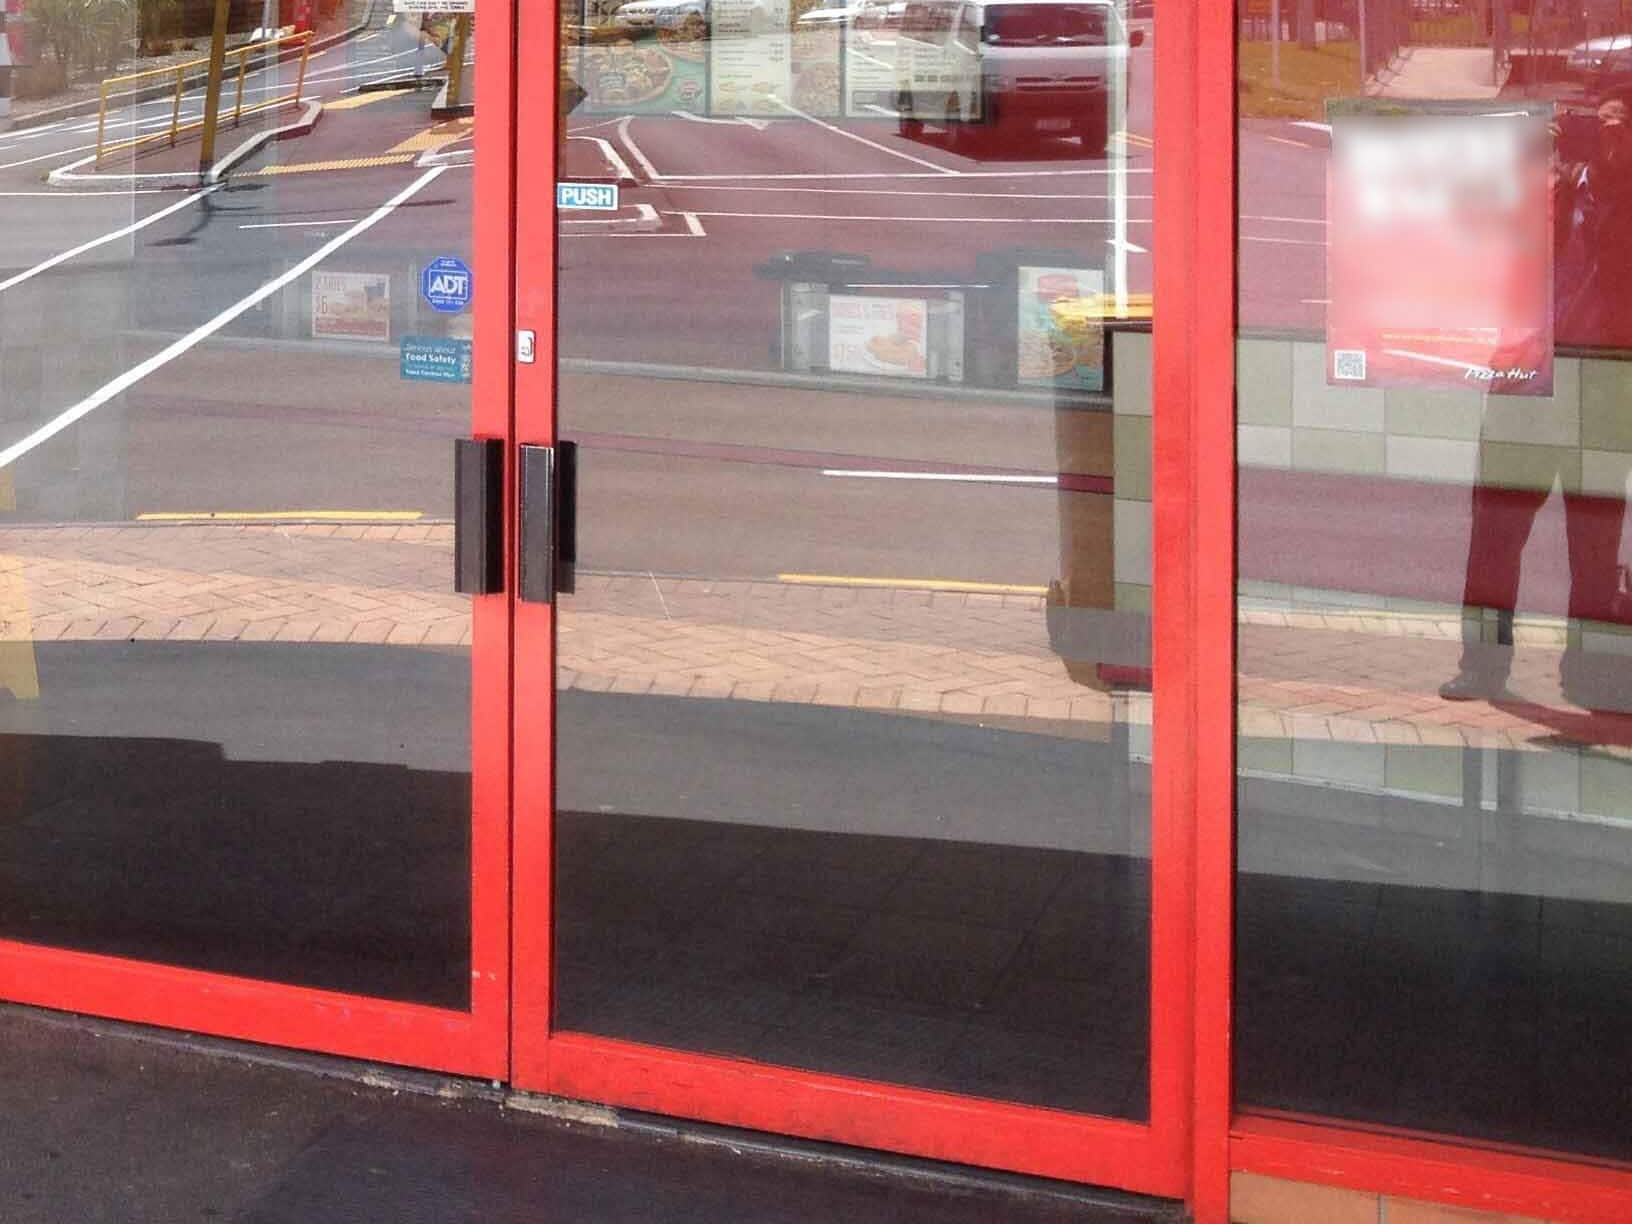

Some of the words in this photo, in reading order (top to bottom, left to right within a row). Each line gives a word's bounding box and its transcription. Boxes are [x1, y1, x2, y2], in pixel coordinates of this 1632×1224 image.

[561, 188, 612, 205] PUSH
[431, 275, 465, 295] ADT
[1507, 367, 1538, 380] Hut
